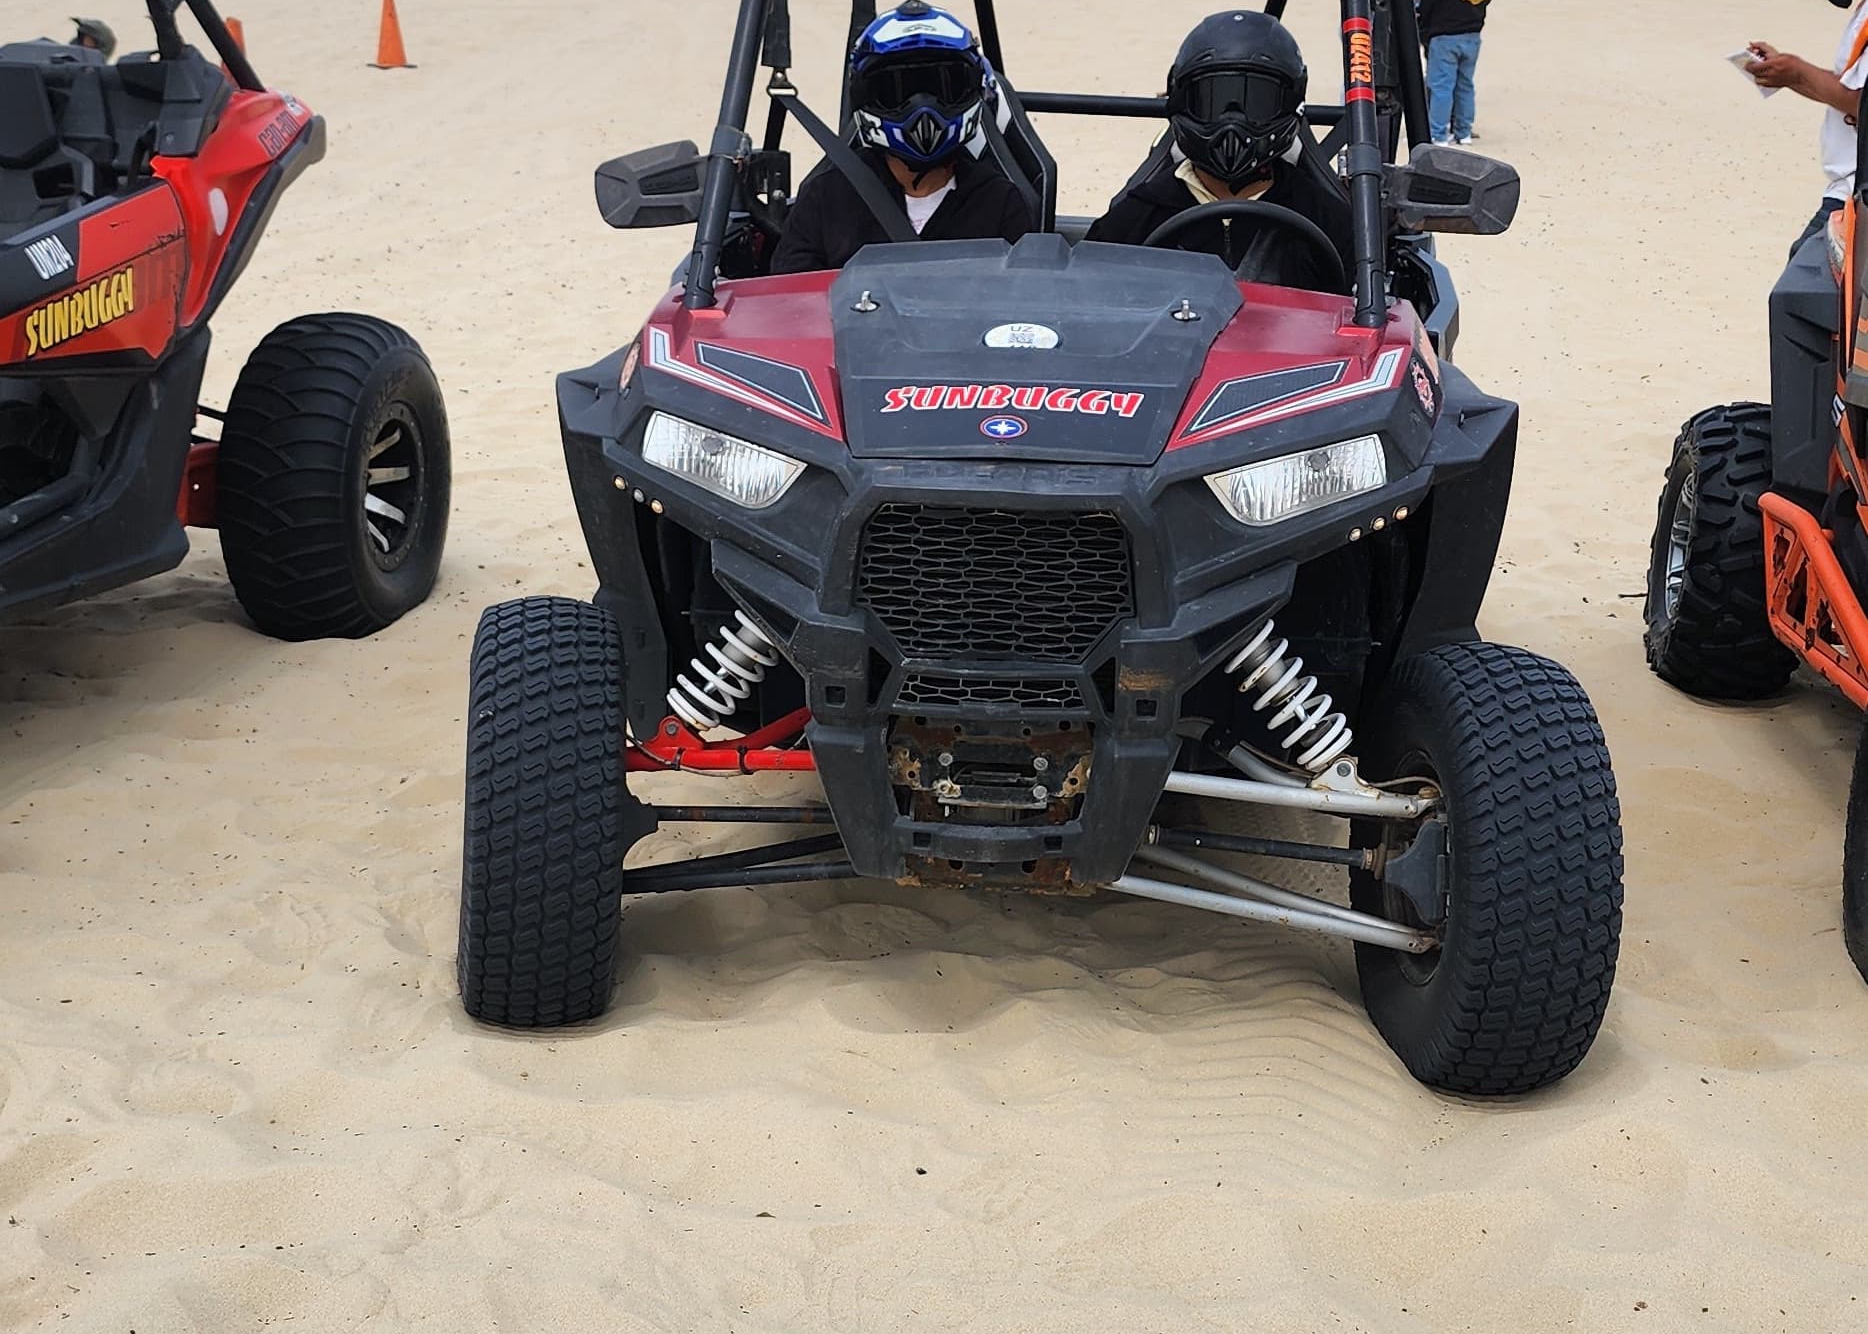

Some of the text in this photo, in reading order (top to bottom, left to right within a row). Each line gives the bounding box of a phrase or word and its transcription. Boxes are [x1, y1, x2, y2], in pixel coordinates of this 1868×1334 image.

[1350, 32, 1372, 83] UZ412
[24, 266, 135, 358] SUNBUGGY
[880, 383, 1145, 418] SUNBUGGY
